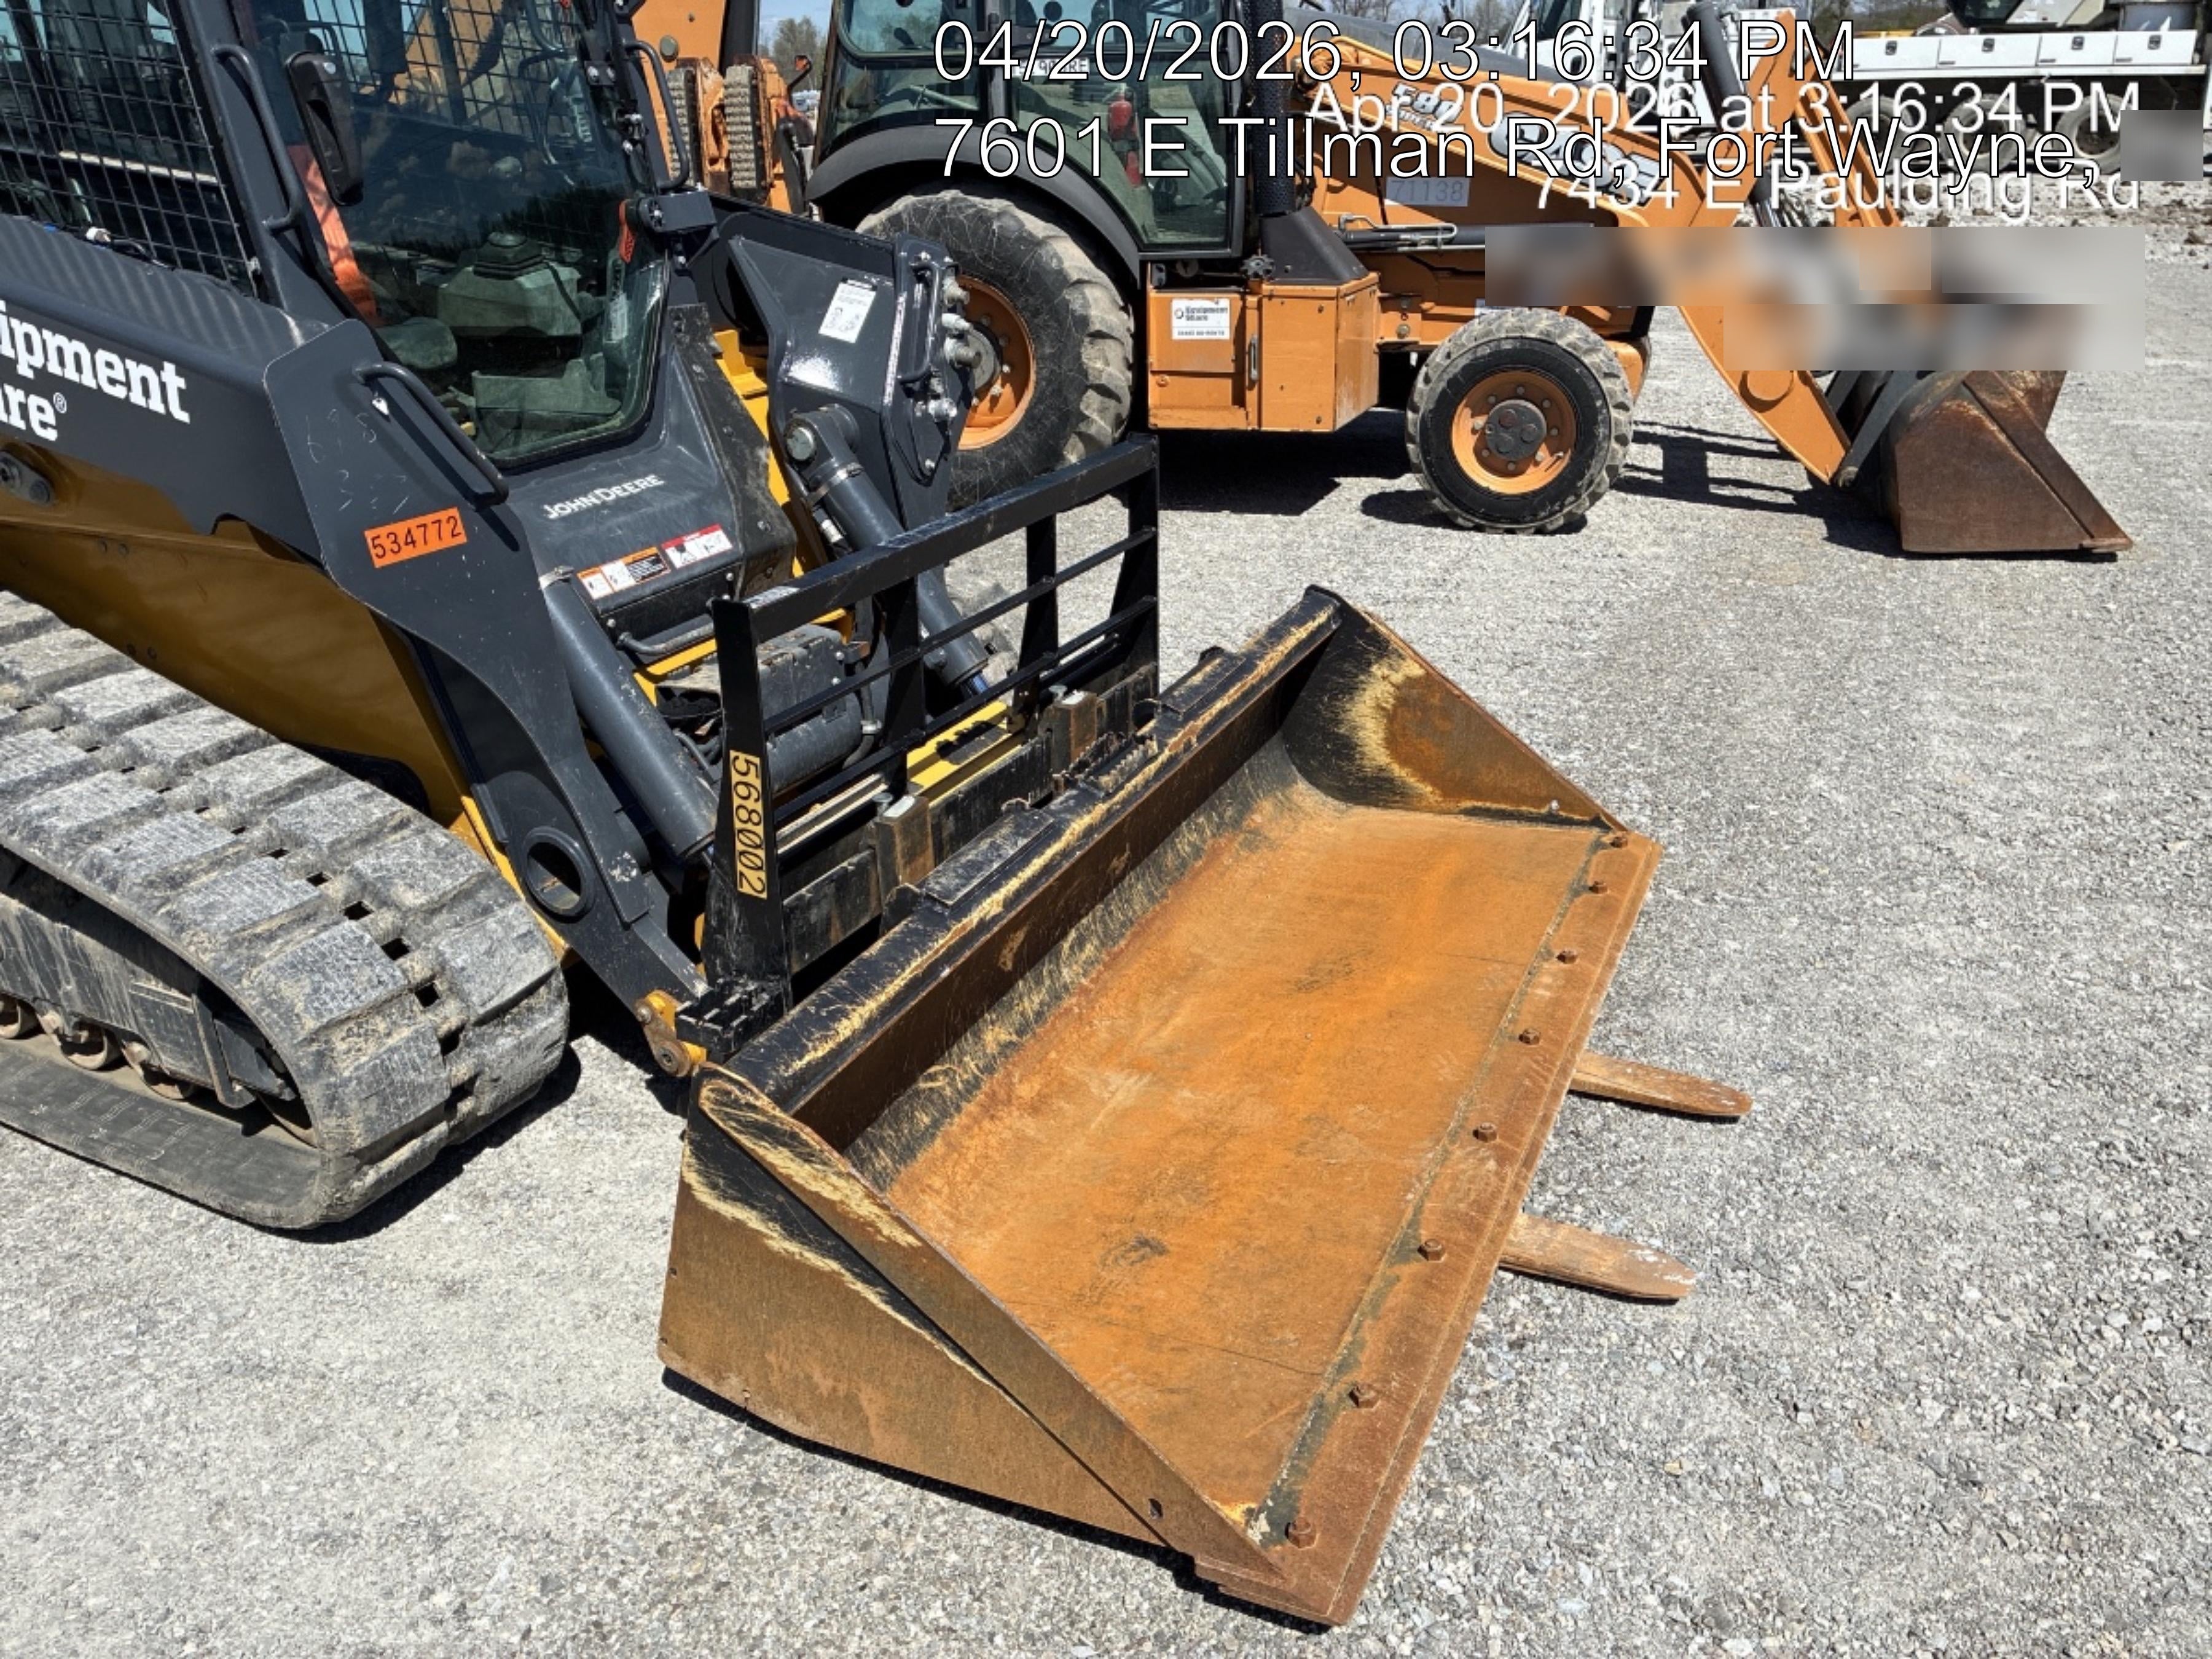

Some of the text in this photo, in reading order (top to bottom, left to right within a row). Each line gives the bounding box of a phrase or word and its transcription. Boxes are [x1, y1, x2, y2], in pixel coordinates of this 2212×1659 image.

[543, 474, 665, 519] JOHN DEERE
[371, 516, 462, 559] 534772
[732, 755, 766, 895] 568002
